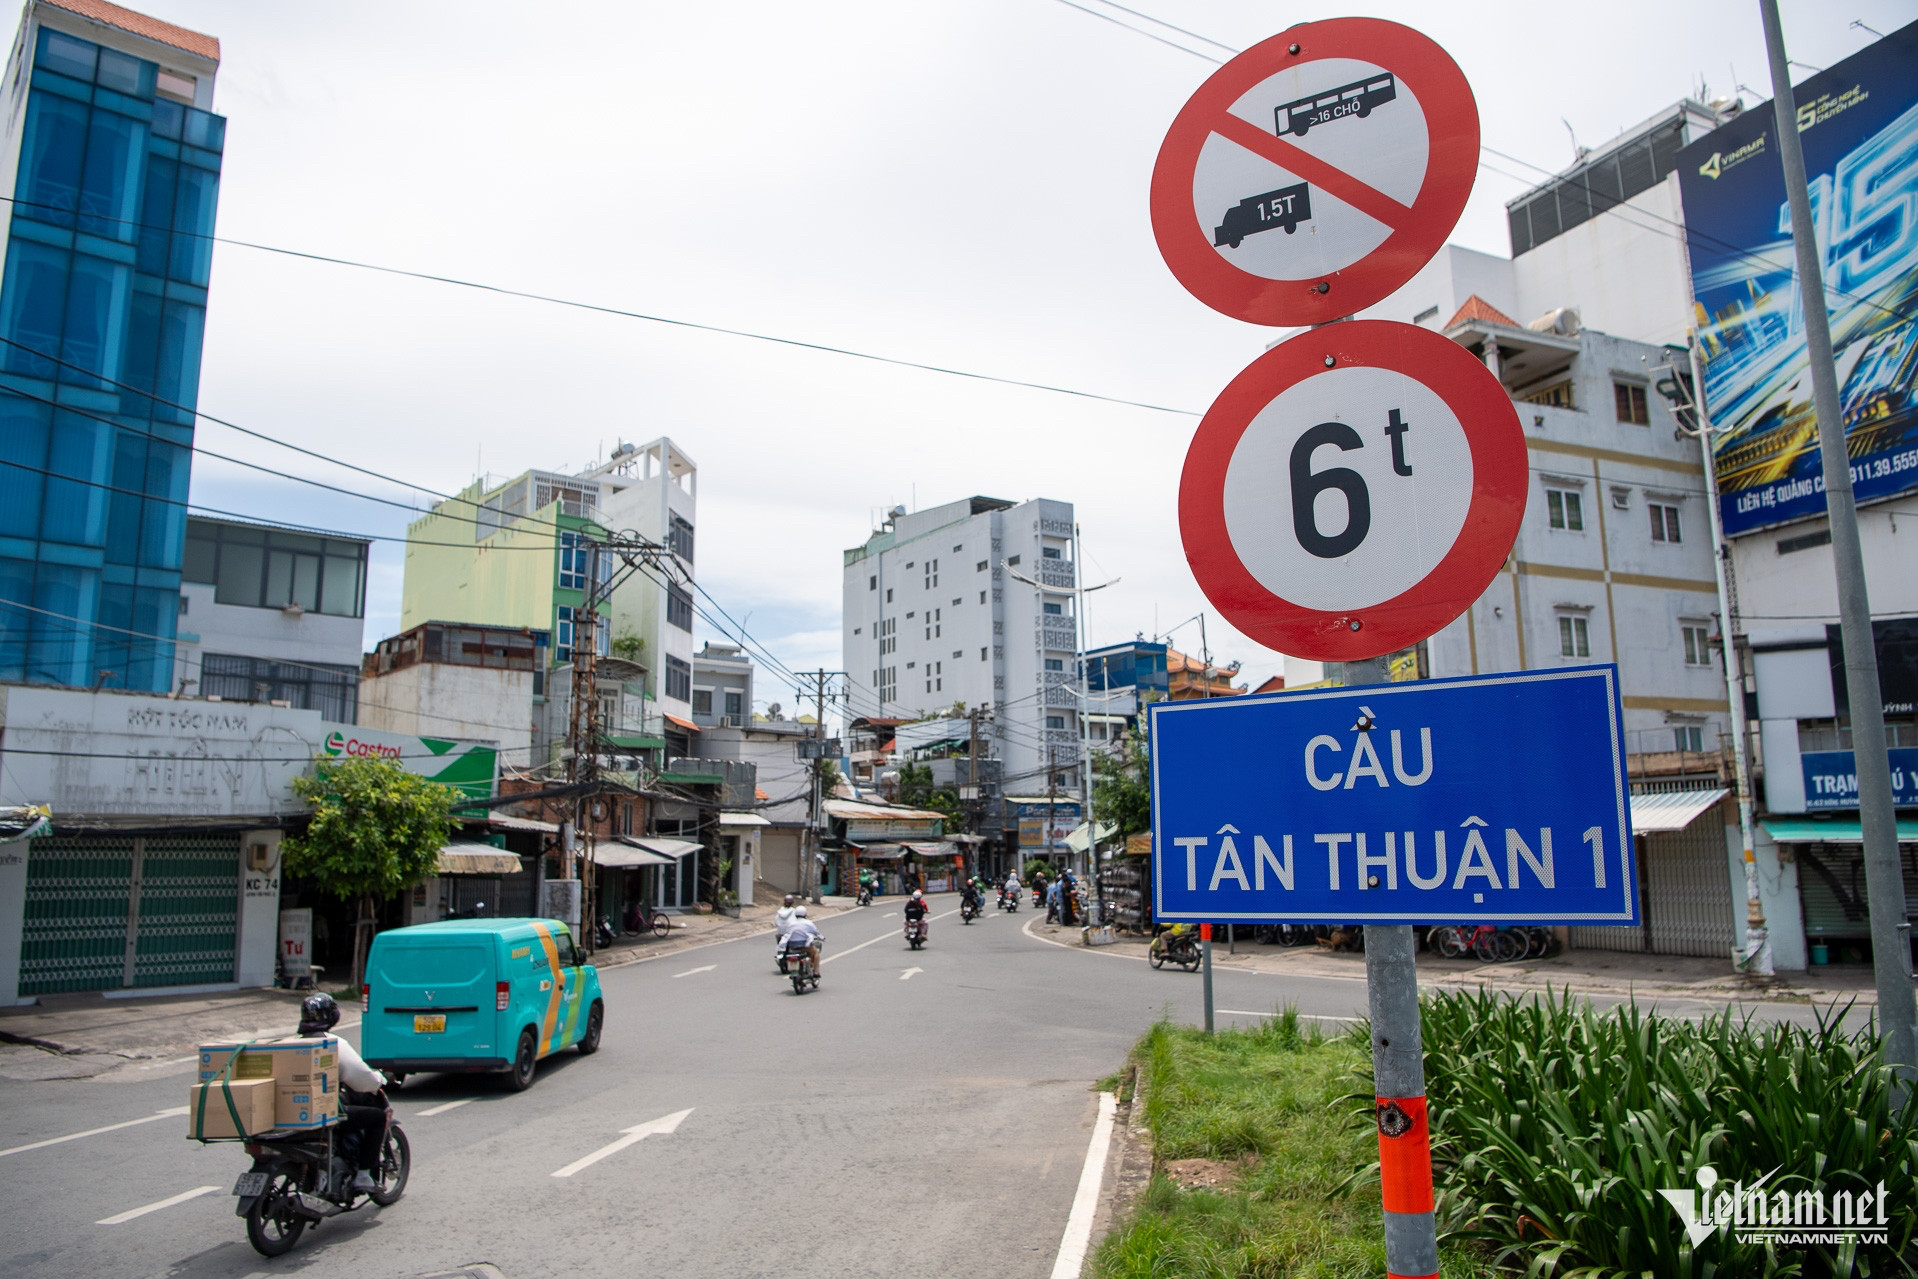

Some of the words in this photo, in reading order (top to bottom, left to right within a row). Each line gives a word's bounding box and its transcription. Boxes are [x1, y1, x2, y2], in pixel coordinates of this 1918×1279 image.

[1333, 96, 1361, 117] CHỖ
[1737, 492, 1761, 514] LIÊN
[1761, 486, 1776, 508] HỆ
[1777, 478, 1813, 503] QUẢNG
[346, 739, 402, 761] Castrol
[1304, 705, 1434, 791] CẦU
[1812, 774, 1858, 796] TRẠM
[1174, 823, 1295, 892] TÂN
[1314, 815, 1556, 904] THUẬN
[1583, 826, 1607, 889] 1
[246, 878, 260, 890] KC
[265, 878, 278, 890] 74
